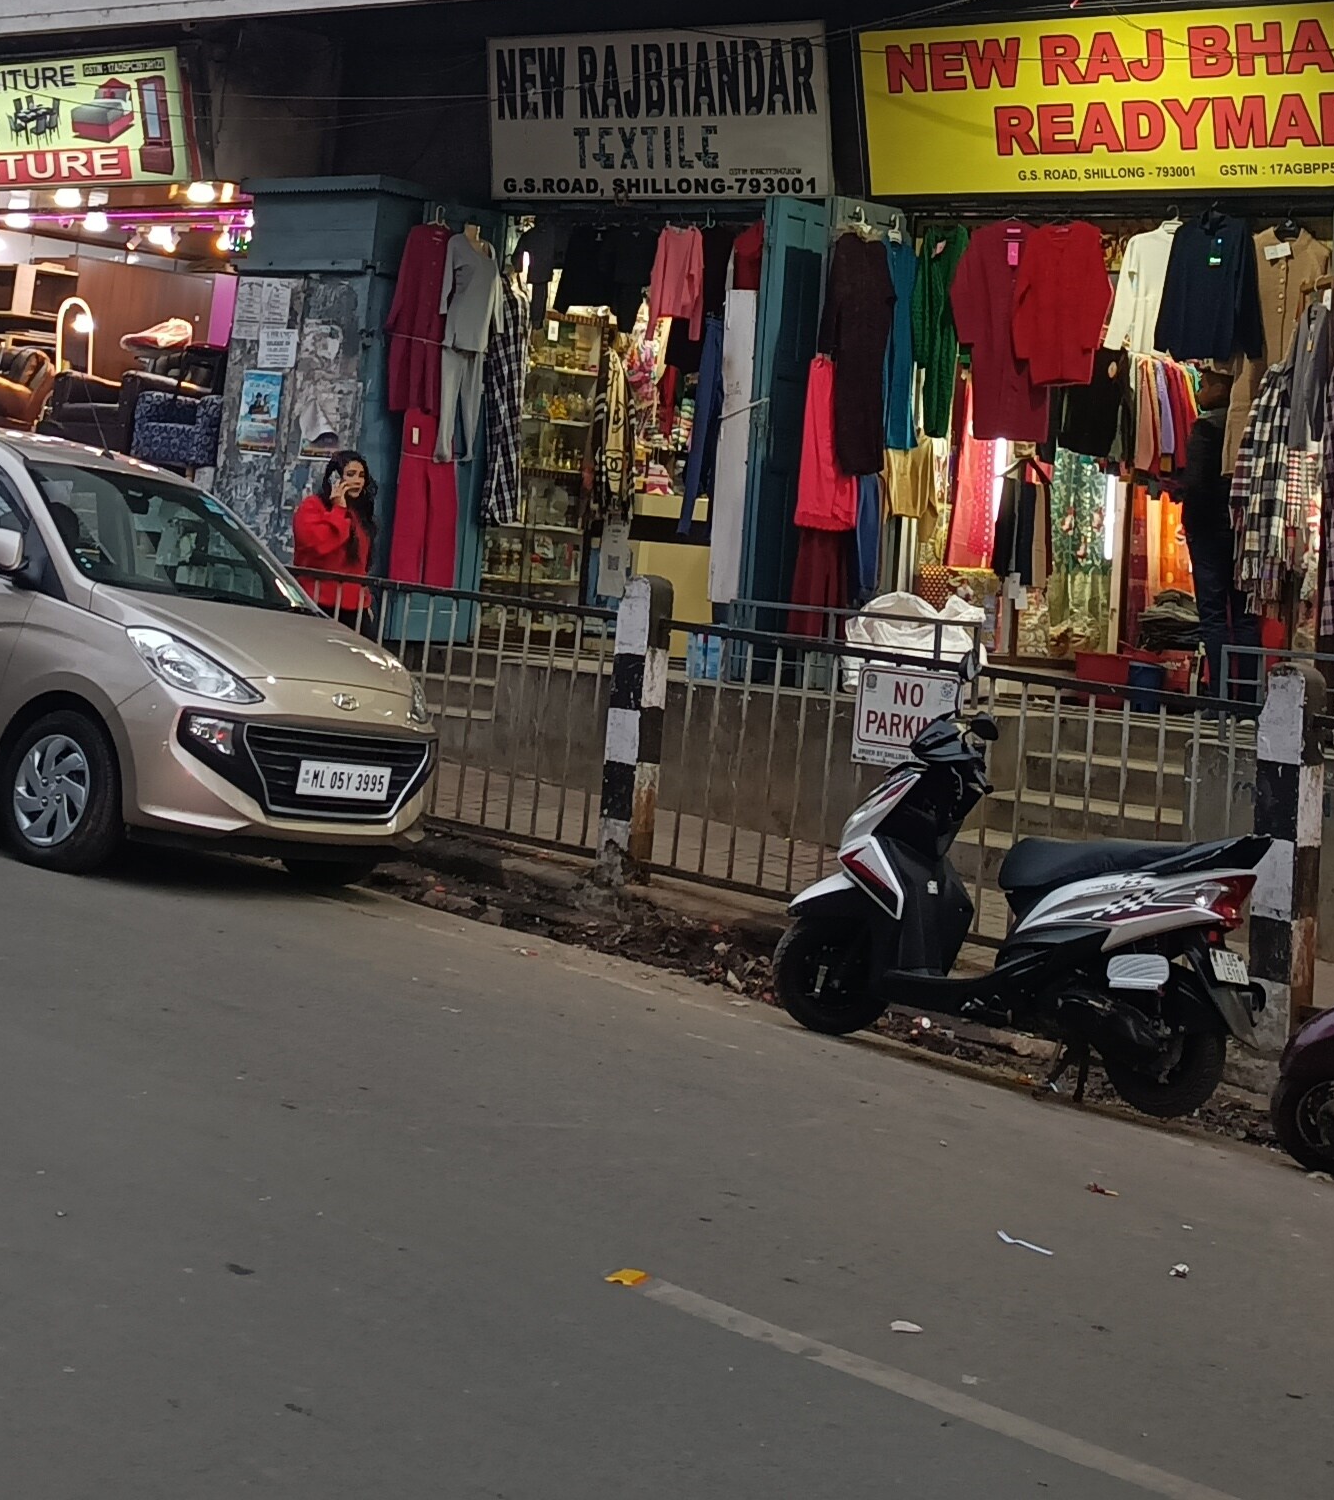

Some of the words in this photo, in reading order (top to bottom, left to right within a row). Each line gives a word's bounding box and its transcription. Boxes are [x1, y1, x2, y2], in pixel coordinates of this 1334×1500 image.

[885, 37, 1020, 93] NEW
[1040, 29, 1164, 86] RAJ
[496, 47, 565, 120] NEW
[577, 37, 817, 119] RAJBHANDAR
[573, 125, 719, 170] TEXTILE
[1018, 169, 1041, 181] G.S.
[1044, 168, 1081, 181] ROAD,
[1084, 167, 1145, 180] SHILLONG
[1156, 166, 1196, 178] 793001
[1220, 164, 1259, 176] GSTIN
[503, 178, 605, 196] G.S.ROAD,
[612, 177, 817, 195] SHILLONG-793001
[894, 681, 924, 707] NO
[355, 773, 385, 793] 3995
